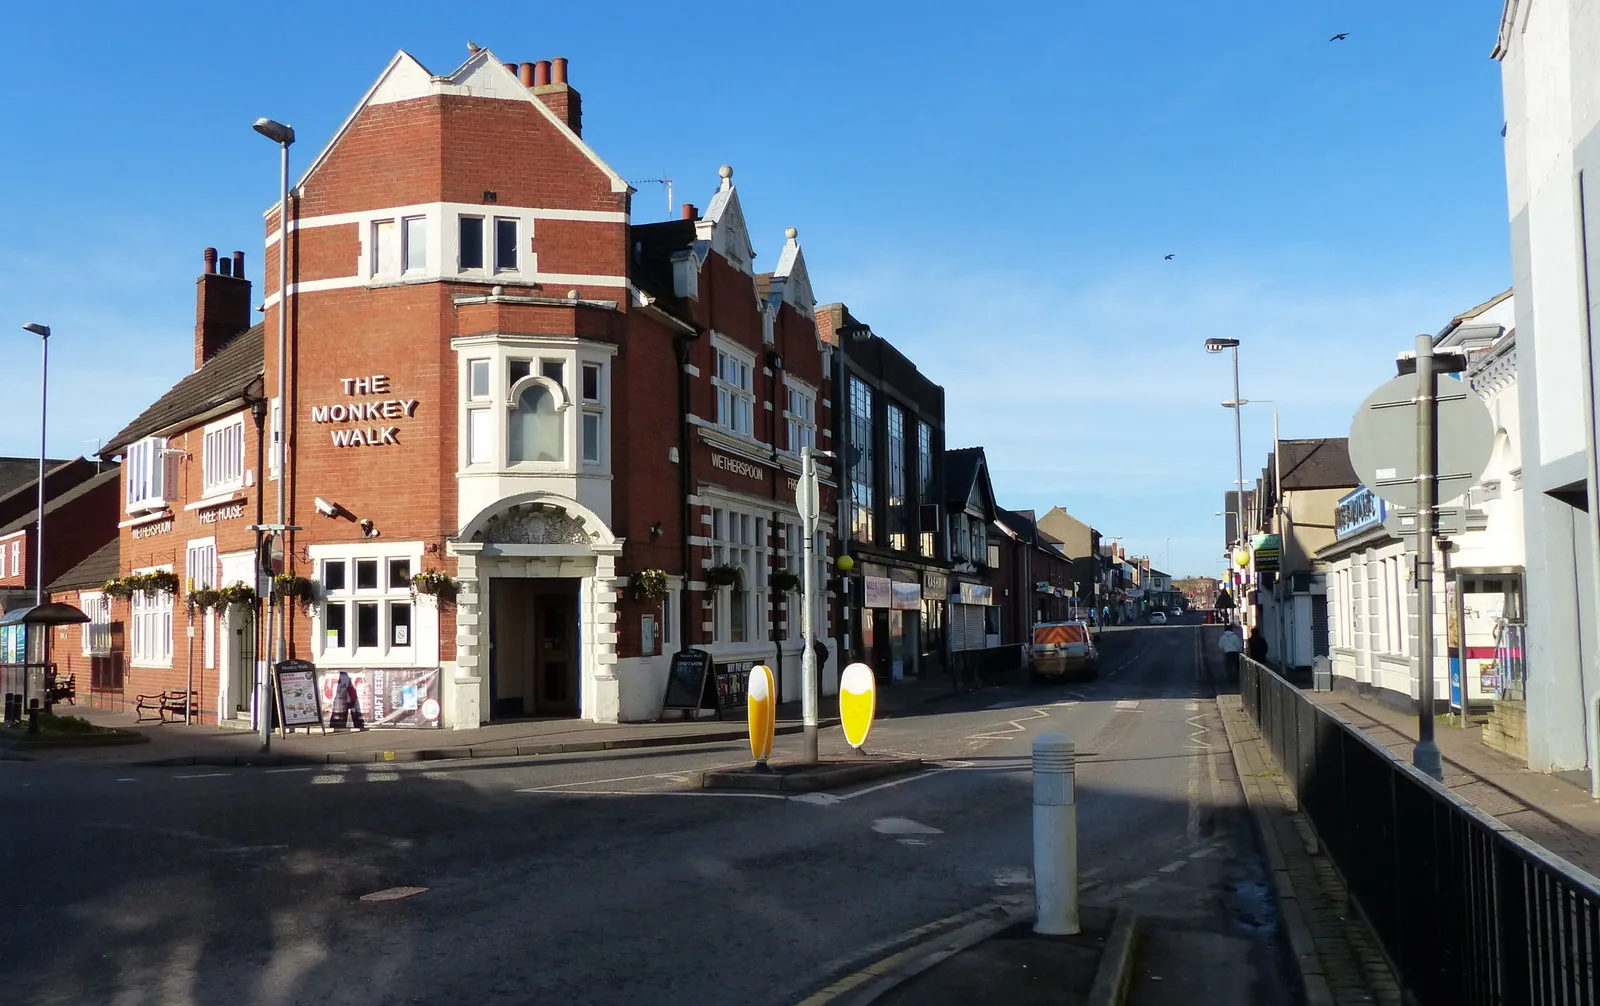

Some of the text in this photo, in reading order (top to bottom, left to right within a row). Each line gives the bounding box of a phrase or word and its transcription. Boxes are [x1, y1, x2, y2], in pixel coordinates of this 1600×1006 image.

[340, 375, 386, 395] THE
[311, 399, 415, 422] MONKEY
[330, 426, 397, 446] WALK
[711, 453, 763, 480] WETHERSPOON
[199, 504, 244, 525] FREE HOUSE
[374, 669, 384, 722] CRAFT BEERS
